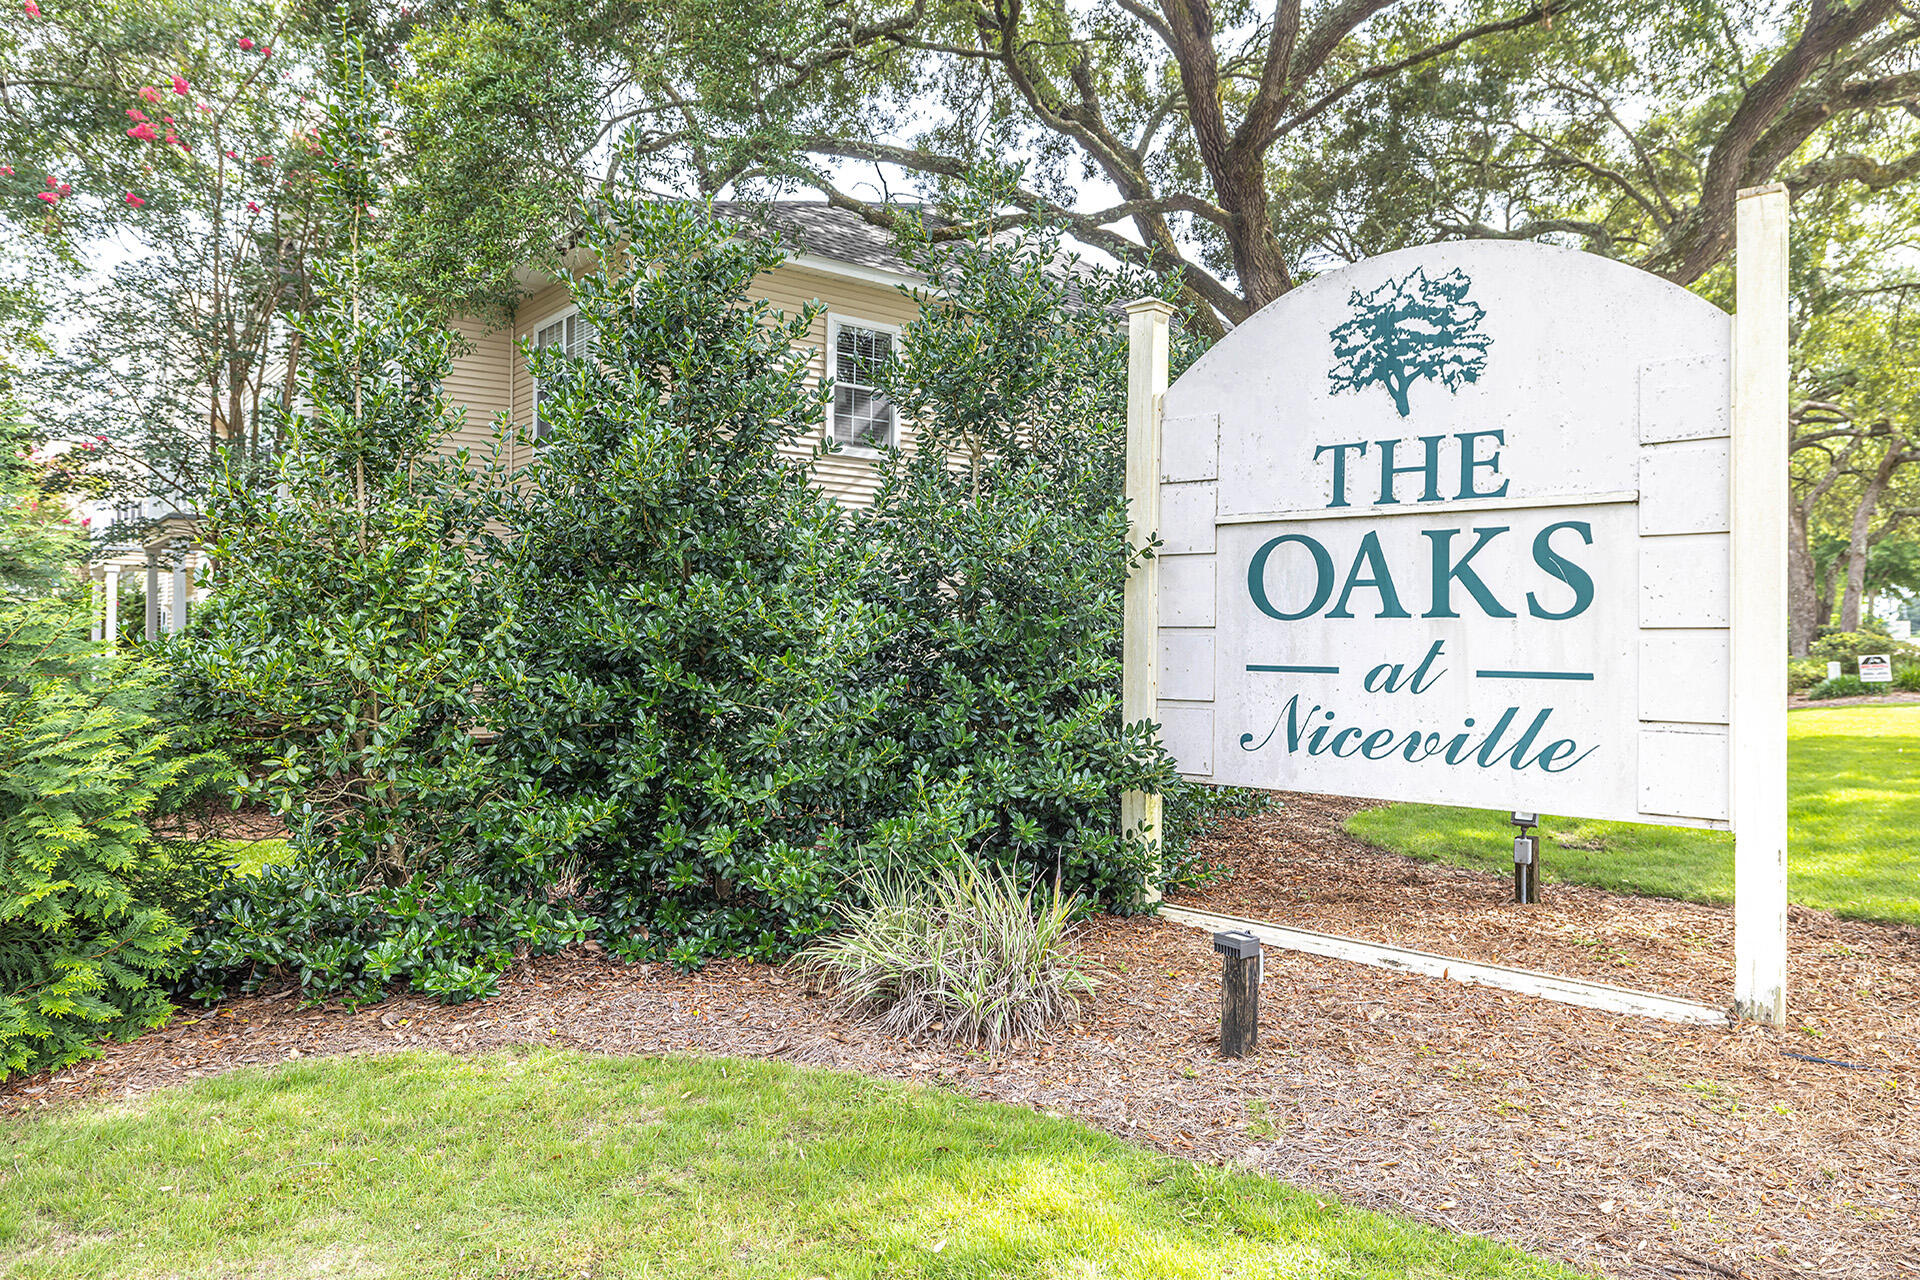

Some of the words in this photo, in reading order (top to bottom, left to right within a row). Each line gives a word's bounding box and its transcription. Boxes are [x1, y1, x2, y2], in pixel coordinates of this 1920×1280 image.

[1313, 429, 1510, 508] THE
[1248, 520, 1595, 621] OAKS
[1363, 639, 1447, 694] at
[1240, 693, 1600, 773] Niceville
